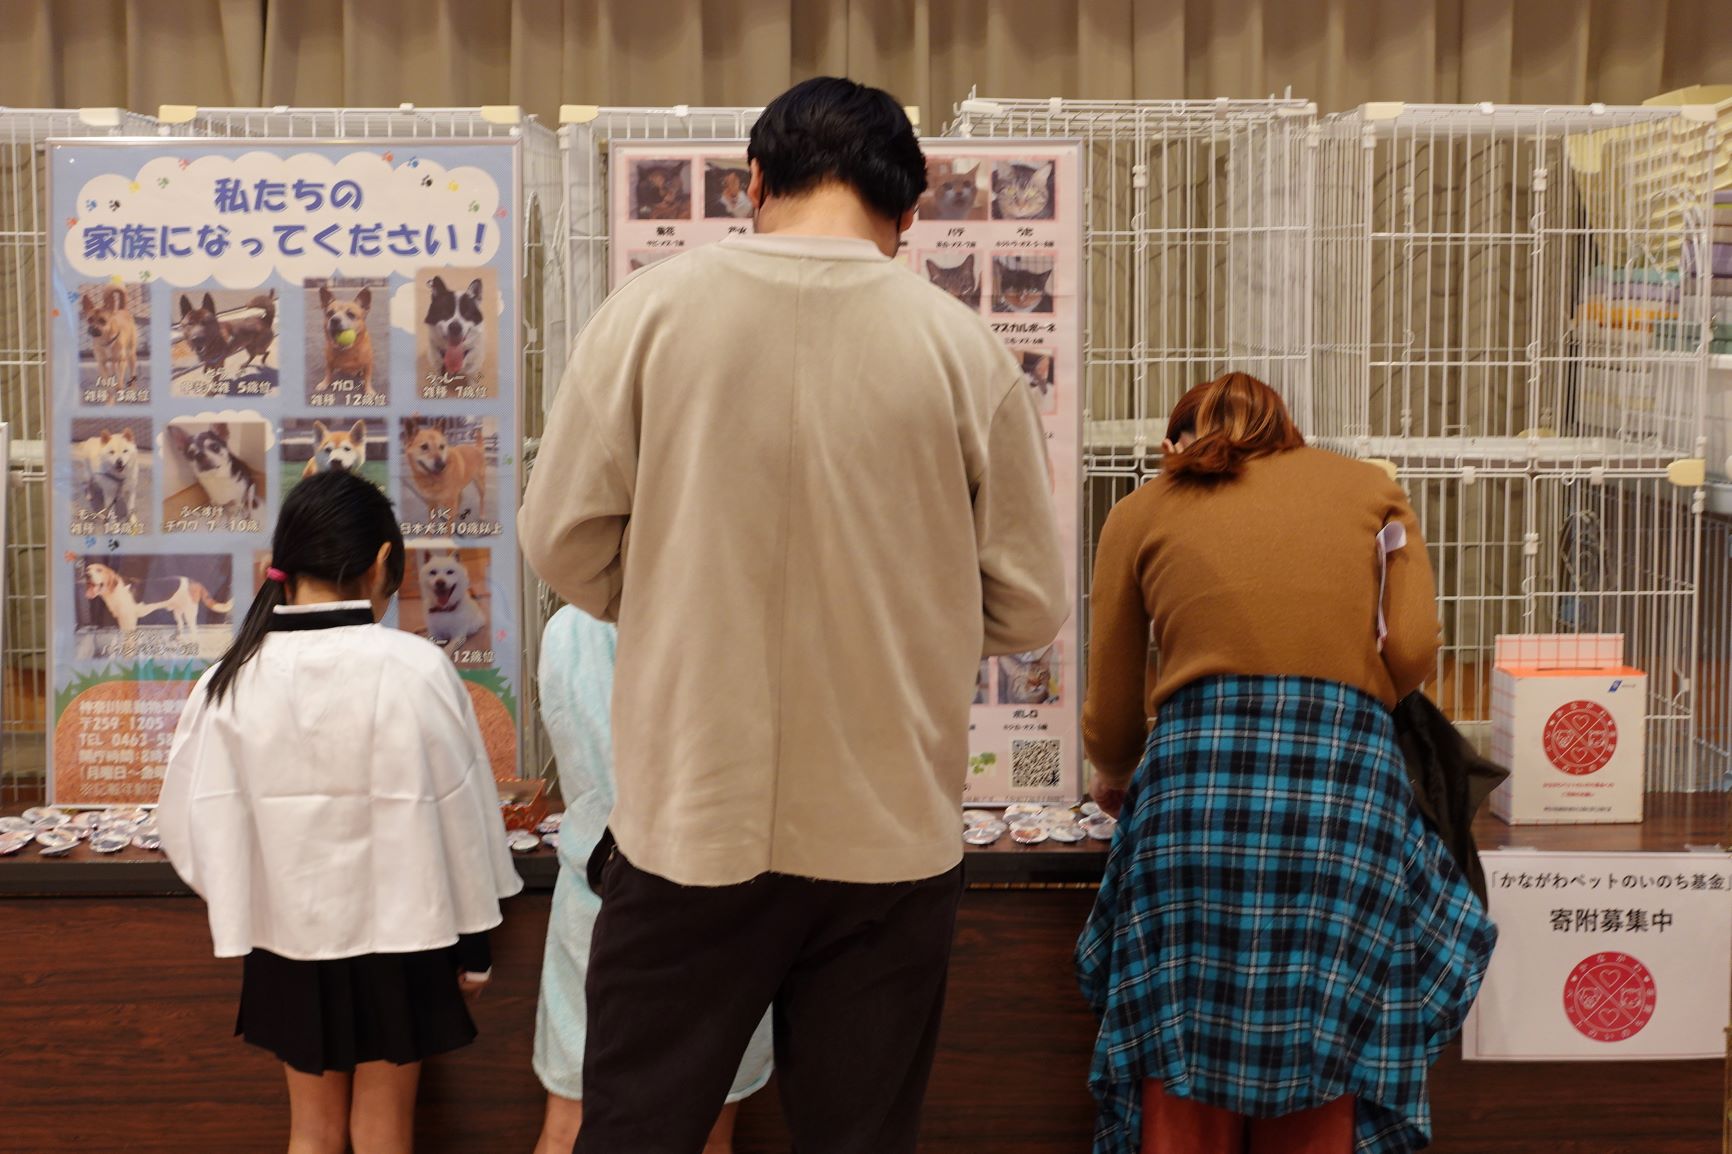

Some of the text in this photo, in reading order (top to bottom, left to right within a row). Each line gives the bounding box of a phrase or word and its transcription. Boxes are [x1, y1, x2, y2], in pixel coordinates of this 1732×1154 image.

[214, 177, 364, 213] 私たちの
[82, 222, 487, 260] 家族になってください!
[79, 733, 104, 747] TEL
[1550, 908, 1673, 933] 寄附募集中
